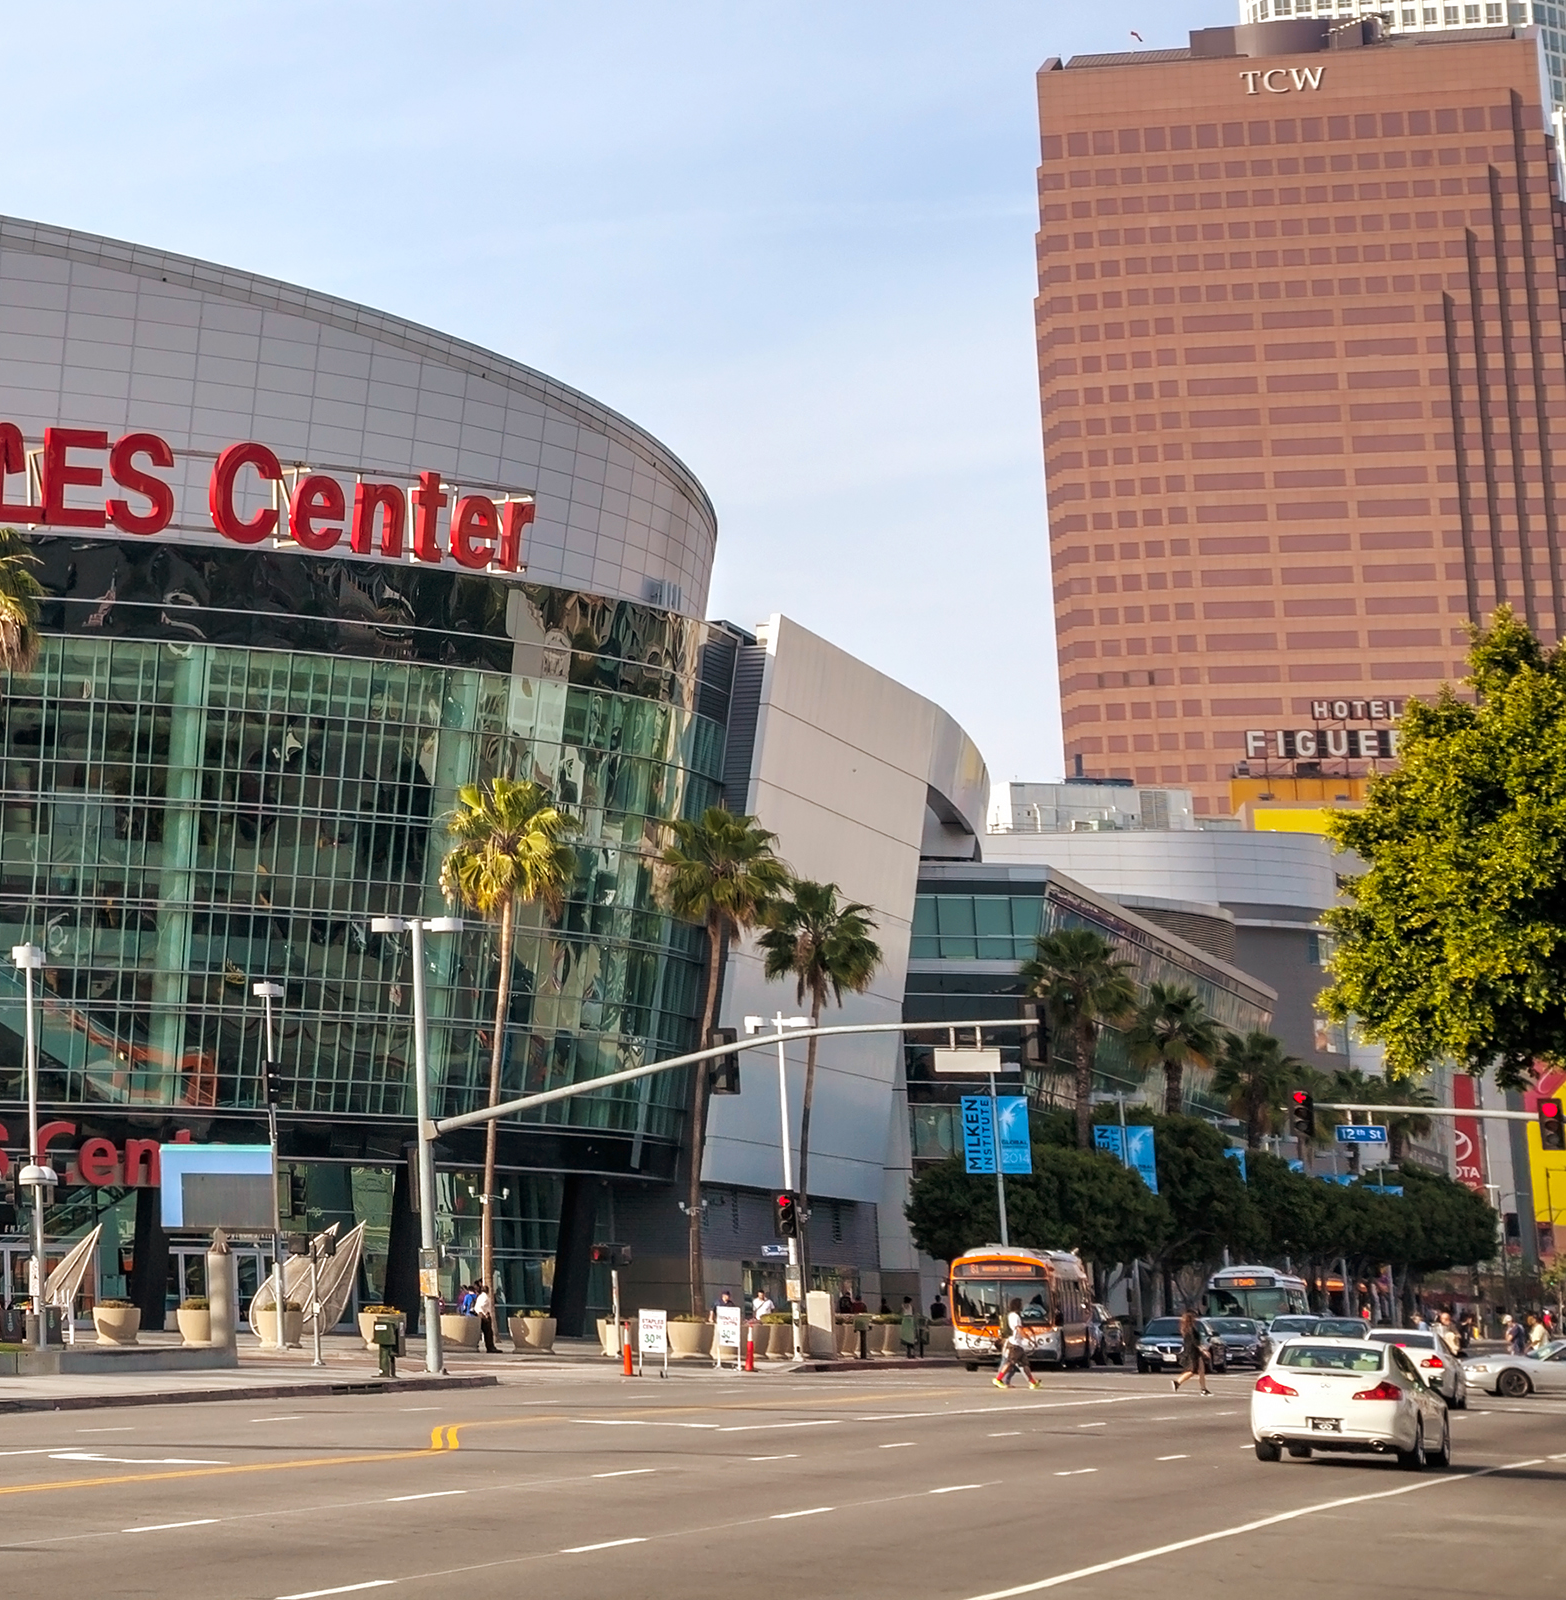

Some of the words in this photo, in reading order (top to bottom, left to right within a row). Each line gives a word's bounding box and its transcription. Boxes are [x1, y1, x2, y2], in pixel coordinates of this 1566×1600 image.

[1238, 65, 1326, 96] TCW
[209, 442, 535, 572] Center
[1312, 700, 1404, 719] HOTEL
[965, 1099, 982, 1171] MILKEN
[979, 1099, 993, 1171] INSTITUTE
[1341, 1128, 1366, 1139] 12th
[1369, 1129, 1382, 1139] St
